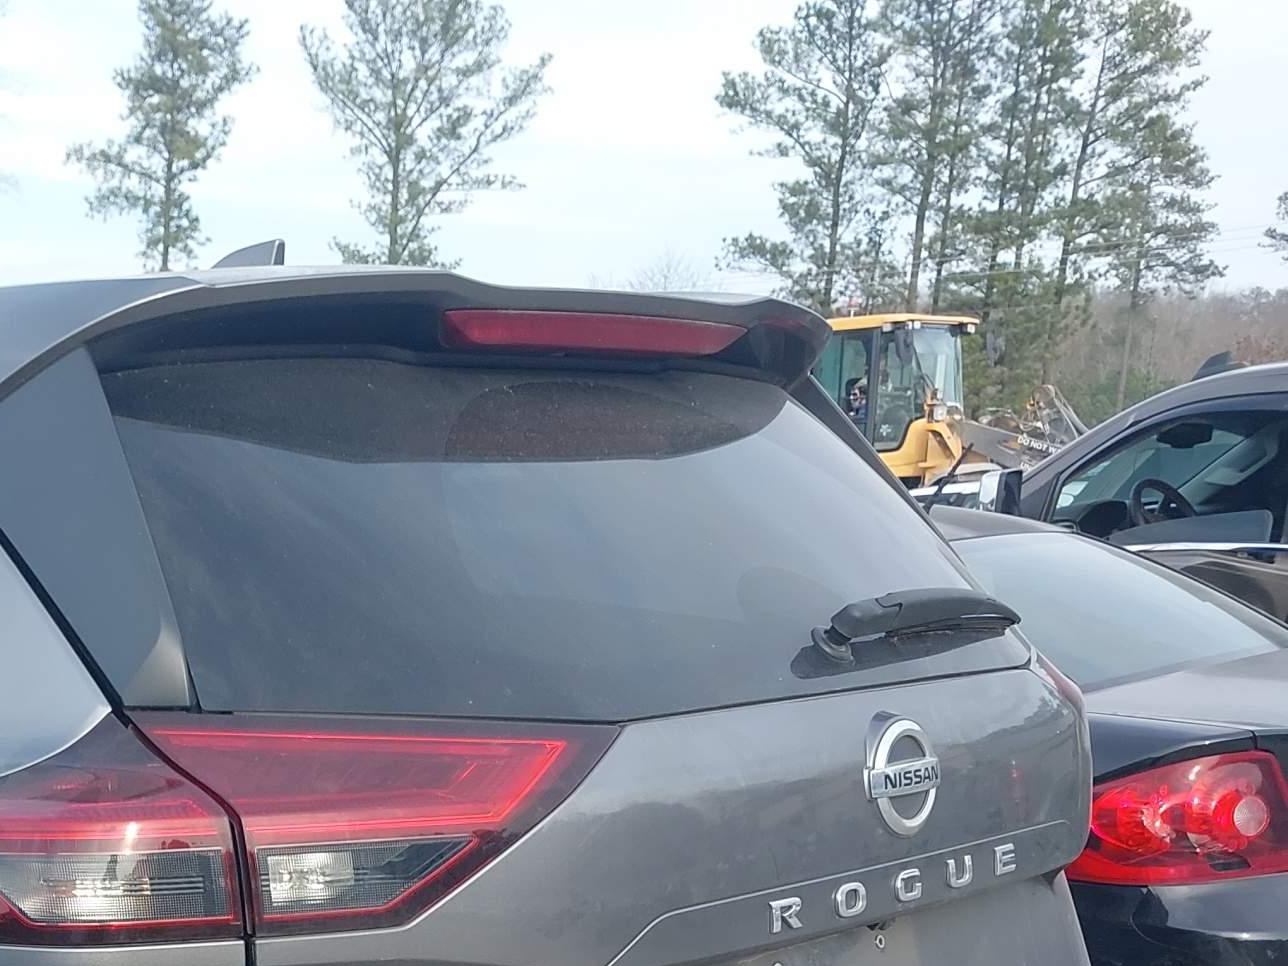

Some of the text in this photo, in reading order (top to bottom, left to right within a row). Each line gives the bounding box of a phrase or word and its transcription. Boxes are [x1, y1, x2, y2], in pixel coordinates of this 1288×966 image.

[1030, 440, 1048, 452] NOT
[884, 766, 939, 790] NISSAN
[768, 843, 1017, 934] ROGUE
